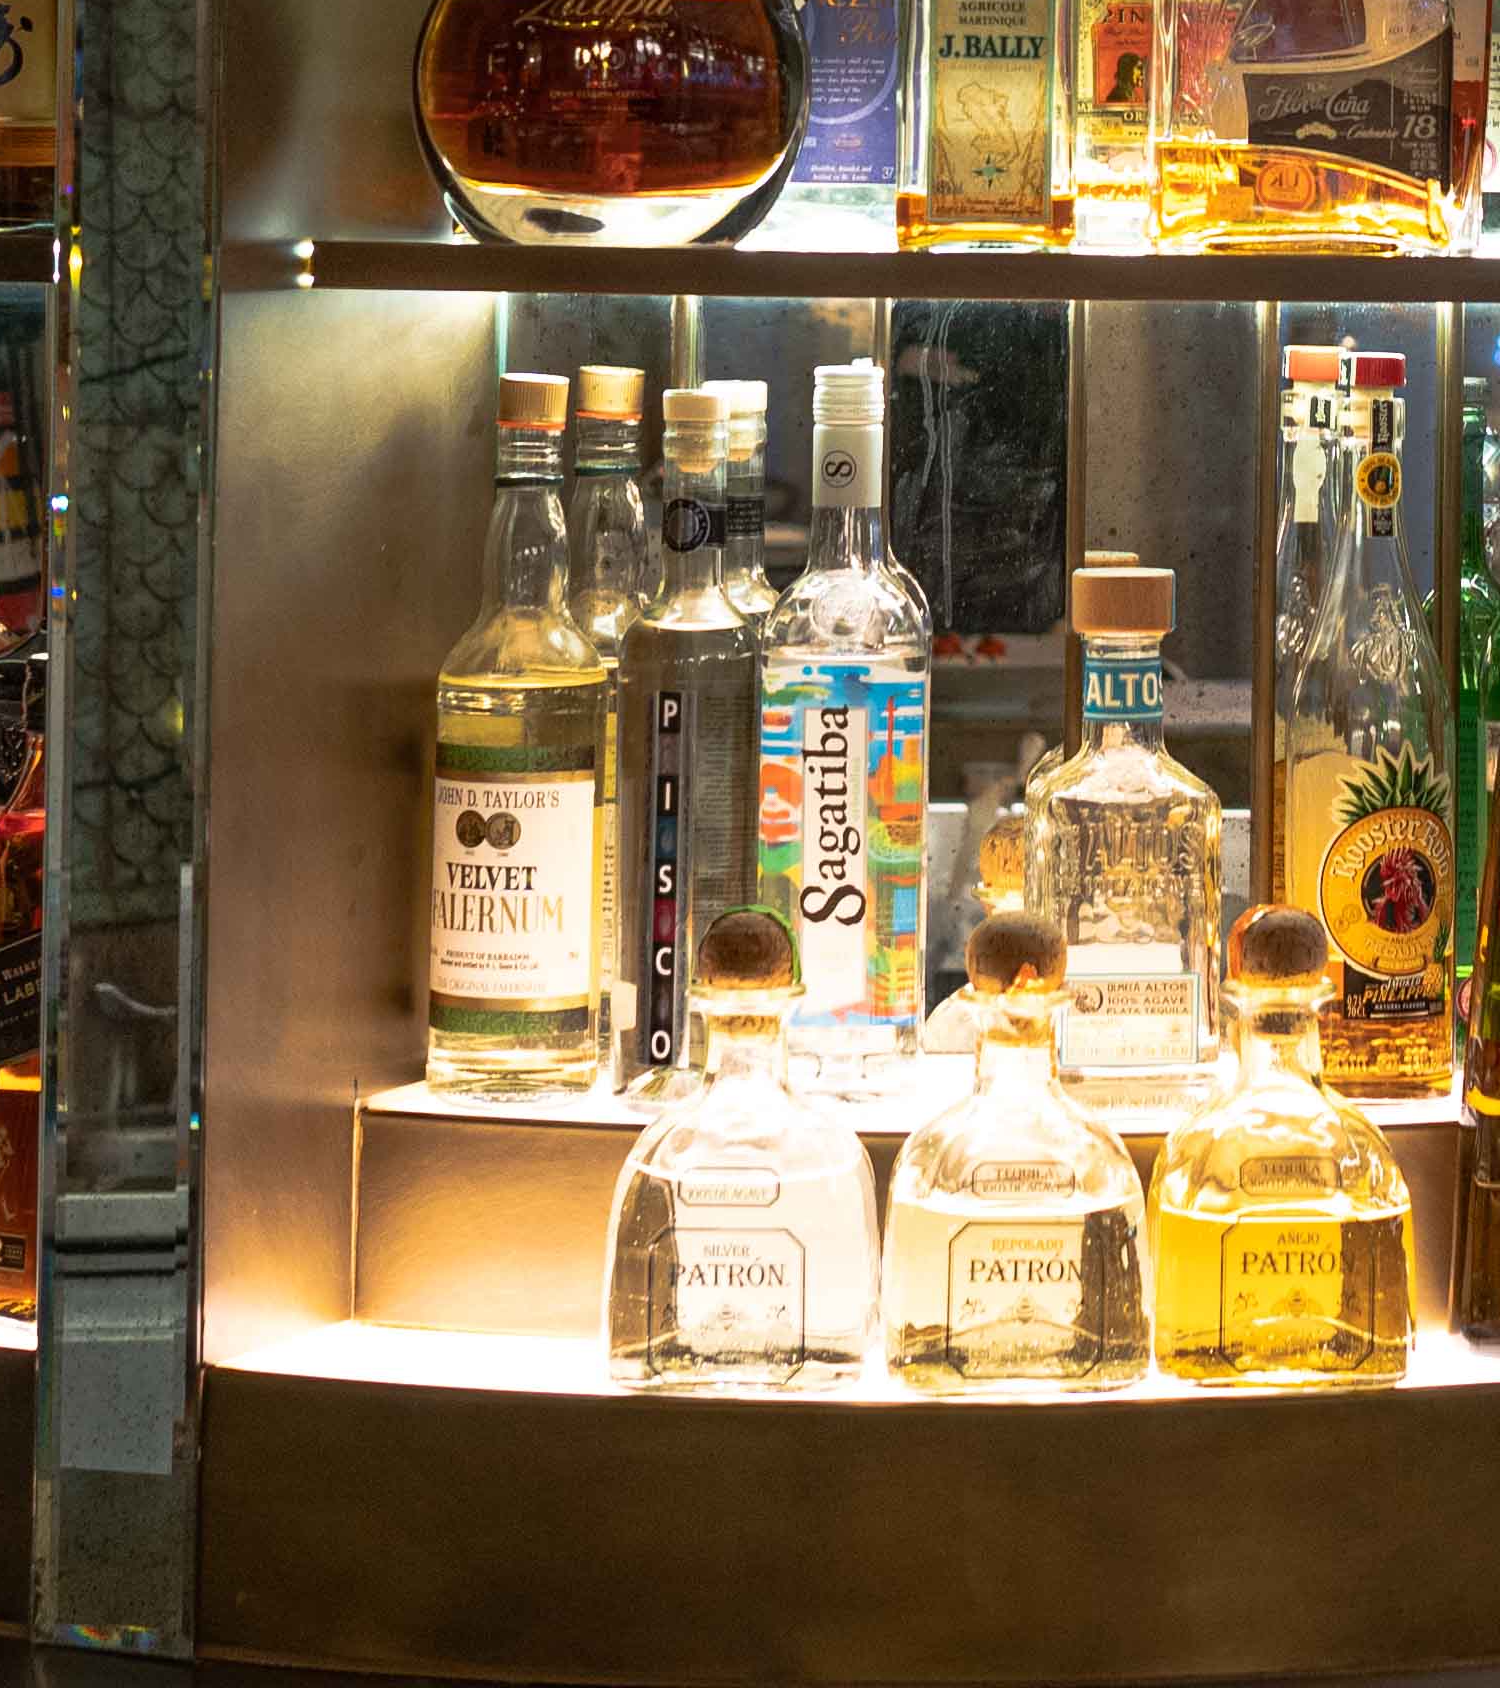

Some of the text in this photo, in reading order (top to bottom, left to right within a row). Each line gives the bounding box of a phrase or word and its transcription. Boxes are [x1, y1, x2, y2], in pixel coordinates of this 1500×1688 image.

[958, 0, 1027, 13] AGRICOLE
[958, 14, 1028, 27] MARTINIQUE
[1325, 87, 1371, 122] Caña
[1402, 115, 1438, 140] 18
[466, 789, 479, 808] D.
[483, 790, 561, 809] TAYLOR'S
[799, 704, 866, 927] Sagatiba
[1330, 816, 1421, 883] Rooster
[445, 861, 538, 892] VELVET
[432, 886, 565, 935] FALERNUM
[1144, 982, 1188, 993] ALTOS
[1143, 995, 1186, 1006] AGAVE
[1144, 1006, 1189, 1016] TEQUILA
[990, 1237, 1065, 1252] REPOSADO
[1276, 1231, 1320, 1245] AÑEJO
[703, 1244, 751, 1258] SILVER
[969, 1253, 1084, 1285] PATRÓN
